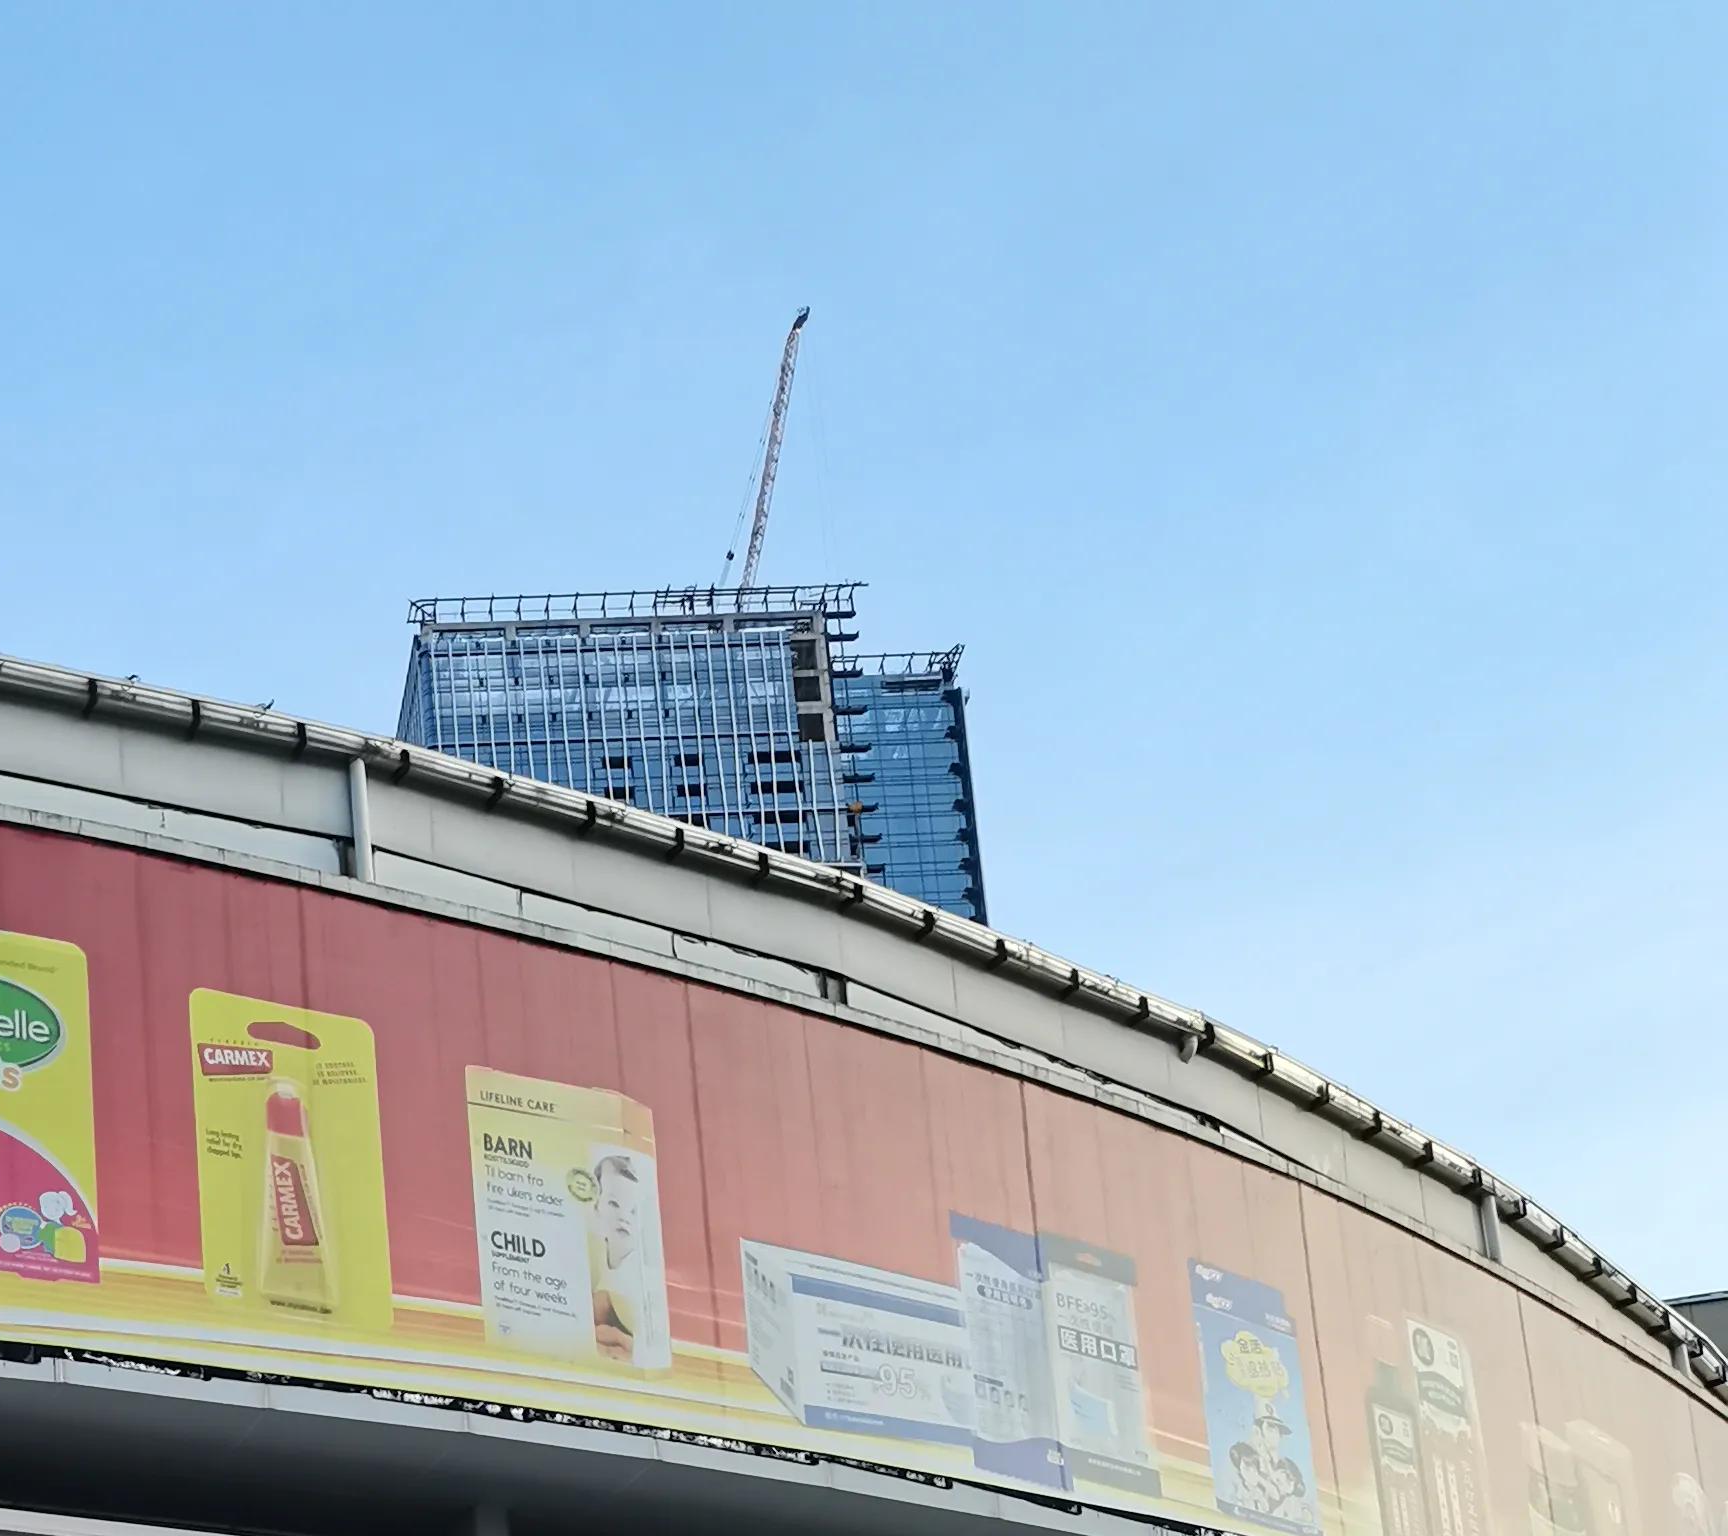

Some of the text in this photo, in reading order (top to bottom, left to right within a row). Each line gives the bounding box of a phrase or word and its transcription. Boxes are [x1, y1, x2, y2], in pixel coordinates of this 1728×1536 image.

[203, 1047, 271, 1069] CARMEX
[480, 1090, 556, 1113] LIFELINE CARE
[483, 1132, 533, 1161] BARN
[497, 1167, 524, 1183] barn
[273, 1161, 304, 1240] CARMEX
[490, 1230, 546, 1258] CHILD
[492, 1261, 568, 1291] From the age
[534, 1290, 568, 1306] weeks
[1060, 1327, 1137, 1367] 医用口罩
